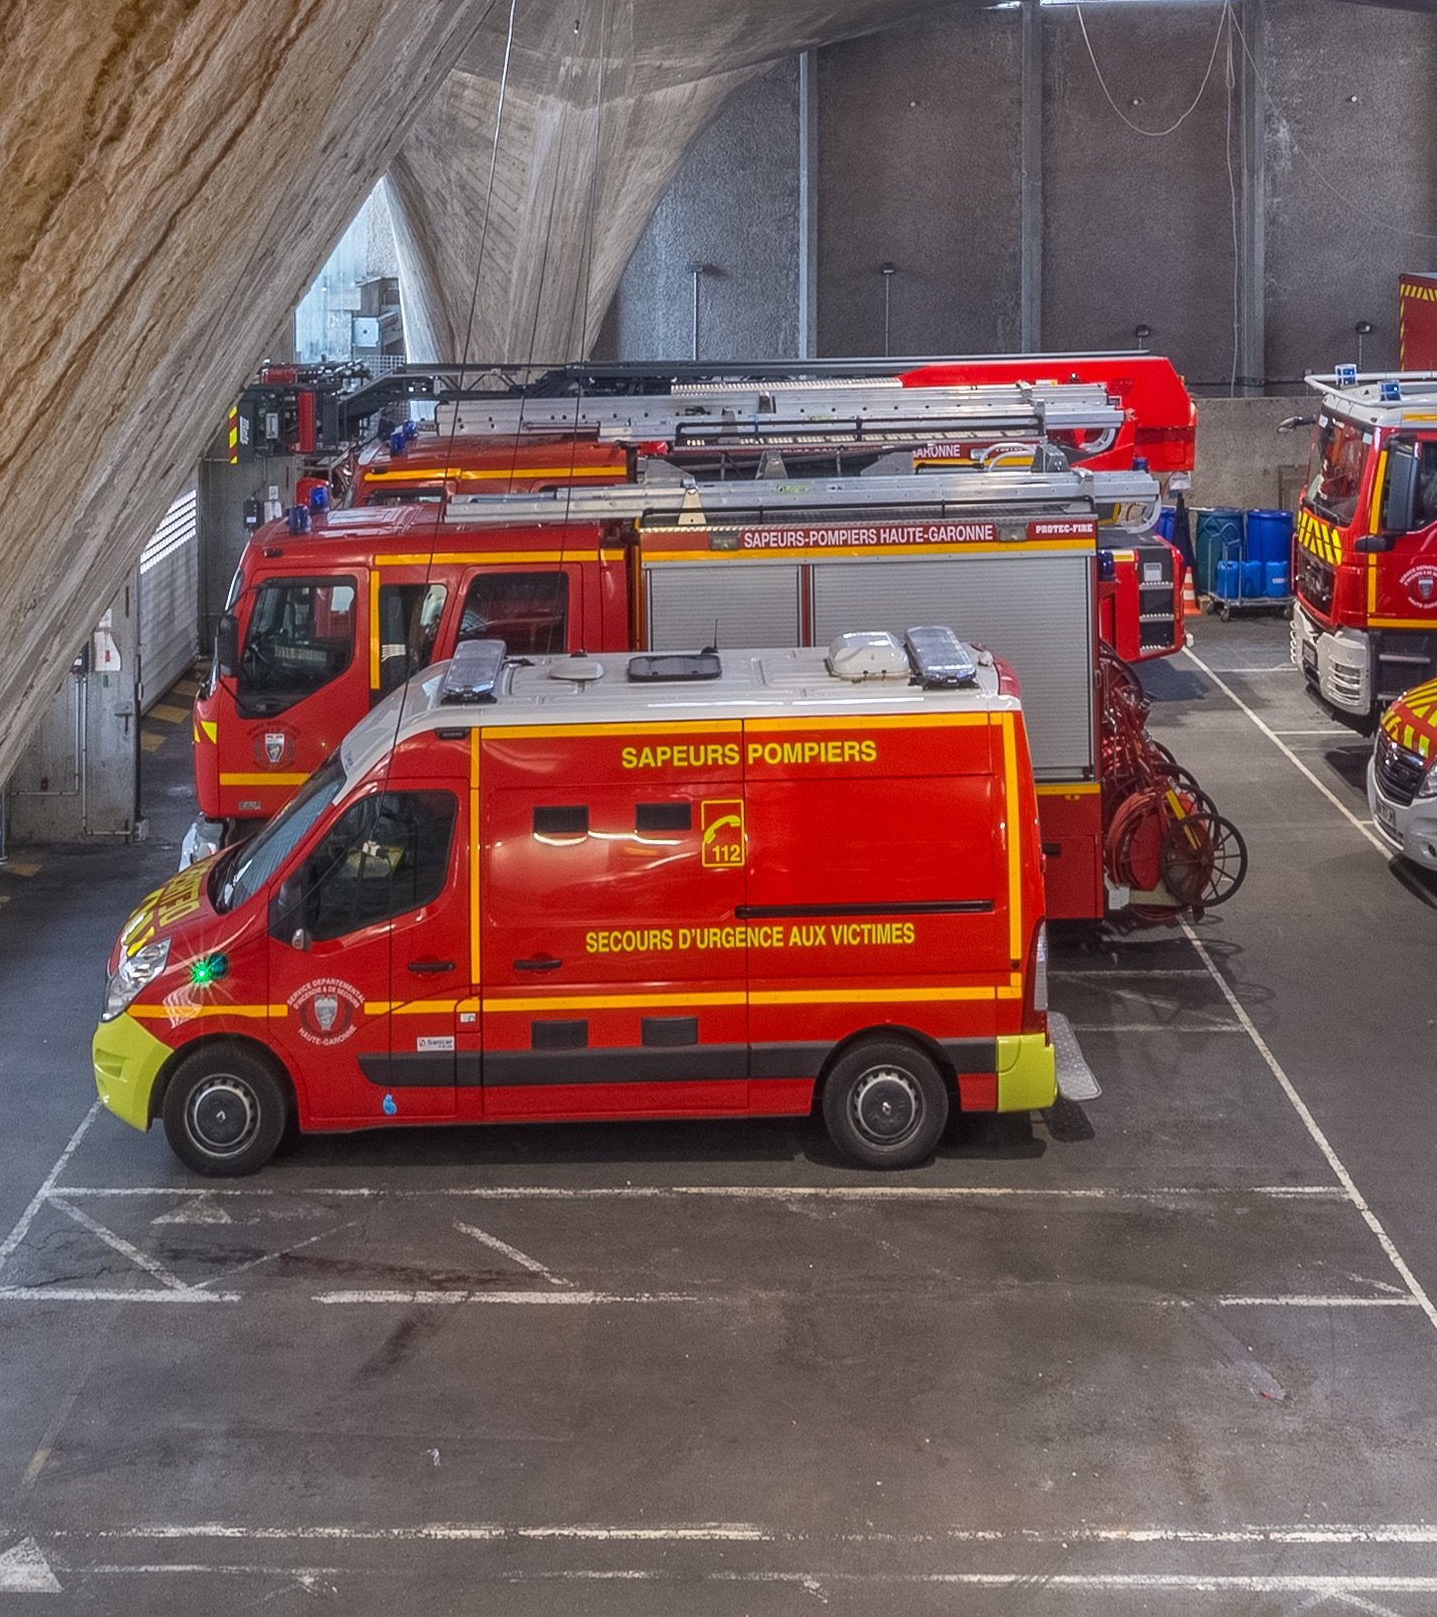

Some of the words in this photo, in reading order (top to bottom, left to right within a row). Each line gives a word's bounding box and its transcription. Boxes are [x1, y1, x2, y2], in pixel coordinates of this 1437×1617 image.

[743, 527, 878, 549] SAPEURS-POMPIERS
[879, 524, 994, 544] HAUTE-GARONNE
[1035, 523, 1093, 534] PROTEC-FIRE
[621, 744, 741, 769] SAPEURS
[747, 740, 878, 765] POMPIERS
[712, 844, 741, 862] 112
[585, 929, 674, 954] SECOURS
[678, 926, 785, 950] D'URGENCE
[788, 925, 828, 948] AUX
[830, 922, 915, 946] VICTIMES
[286, 981, 313, 1006] SERVICE
[297, 1024, 358, 1046] HAUTE-GARONNE
